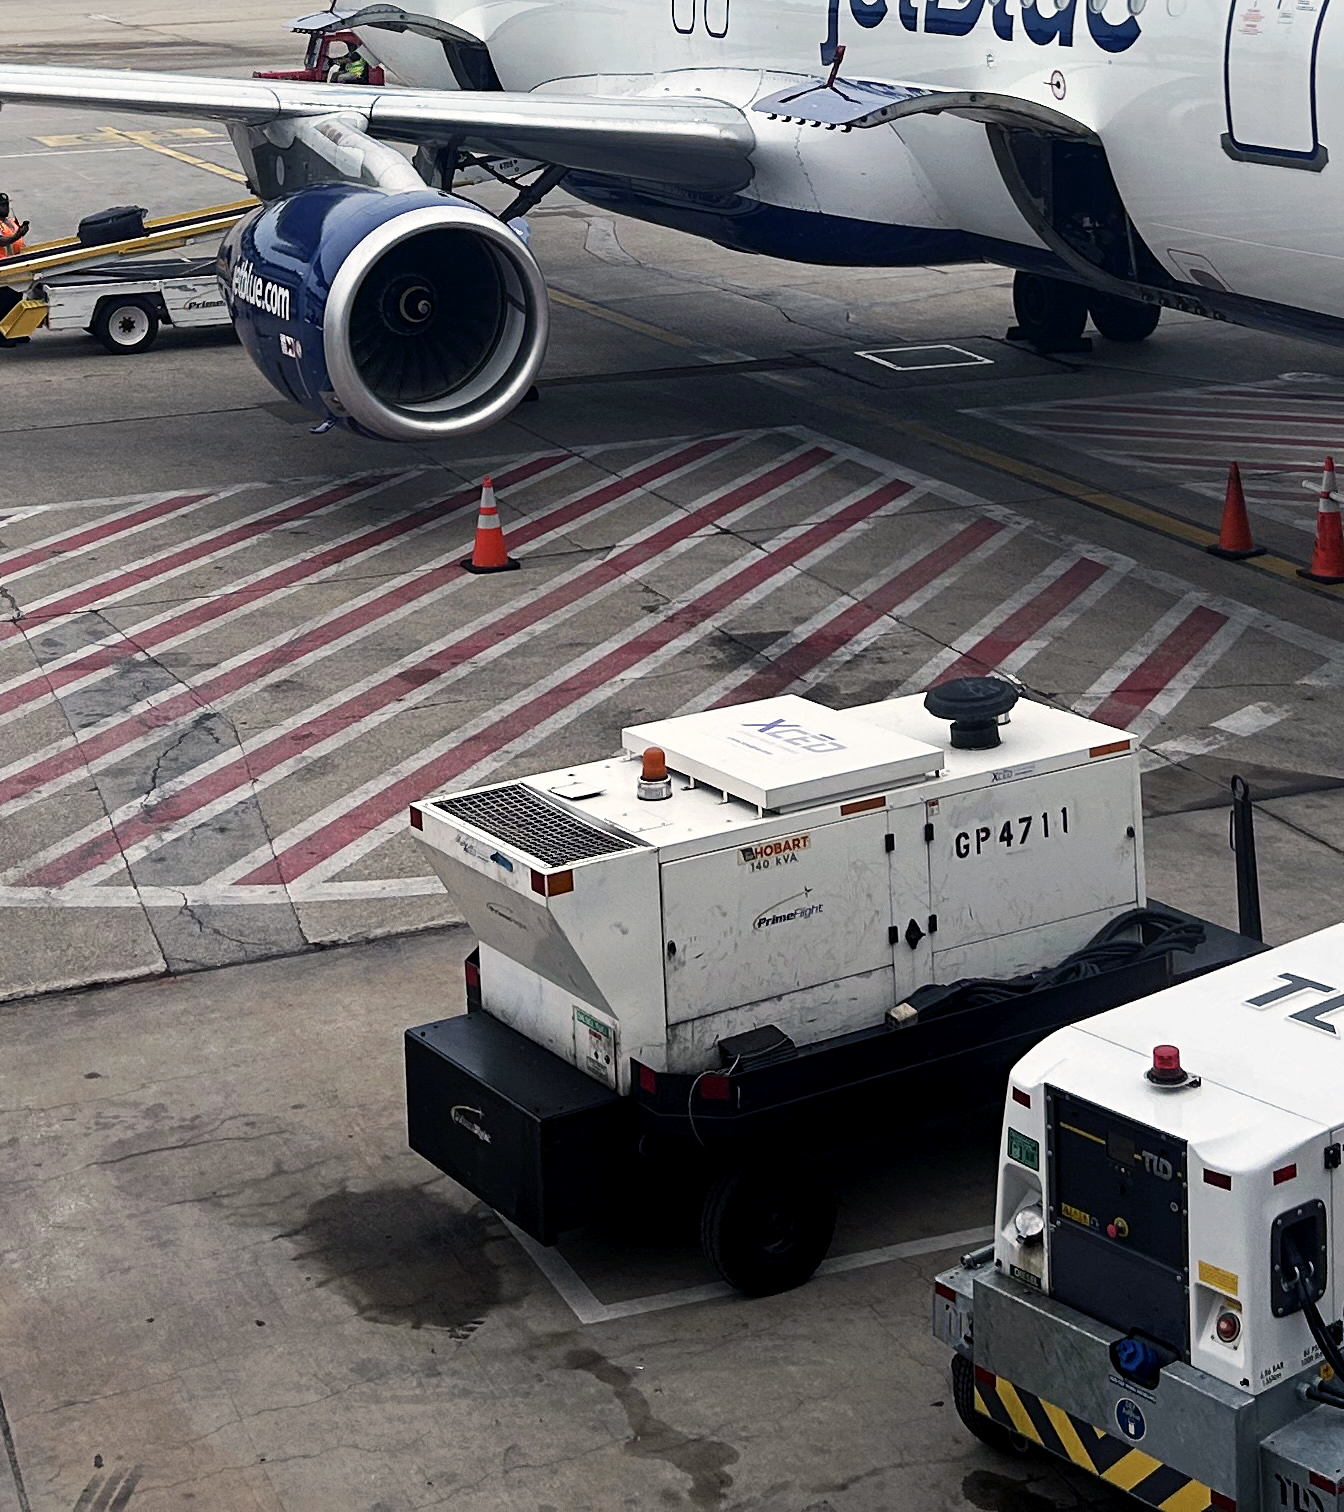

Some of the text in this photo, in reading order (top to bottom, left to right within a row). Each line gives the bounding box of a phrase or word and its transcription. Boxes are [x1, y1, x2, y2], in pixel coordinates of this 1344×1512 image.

[754, 835, 809, 859] HOBART
[750, 852, 799, 873] 140 kVA
[757, 904, 824, 929] PrimeFlight
[1141, 1149, 1173, 1182] TLD
